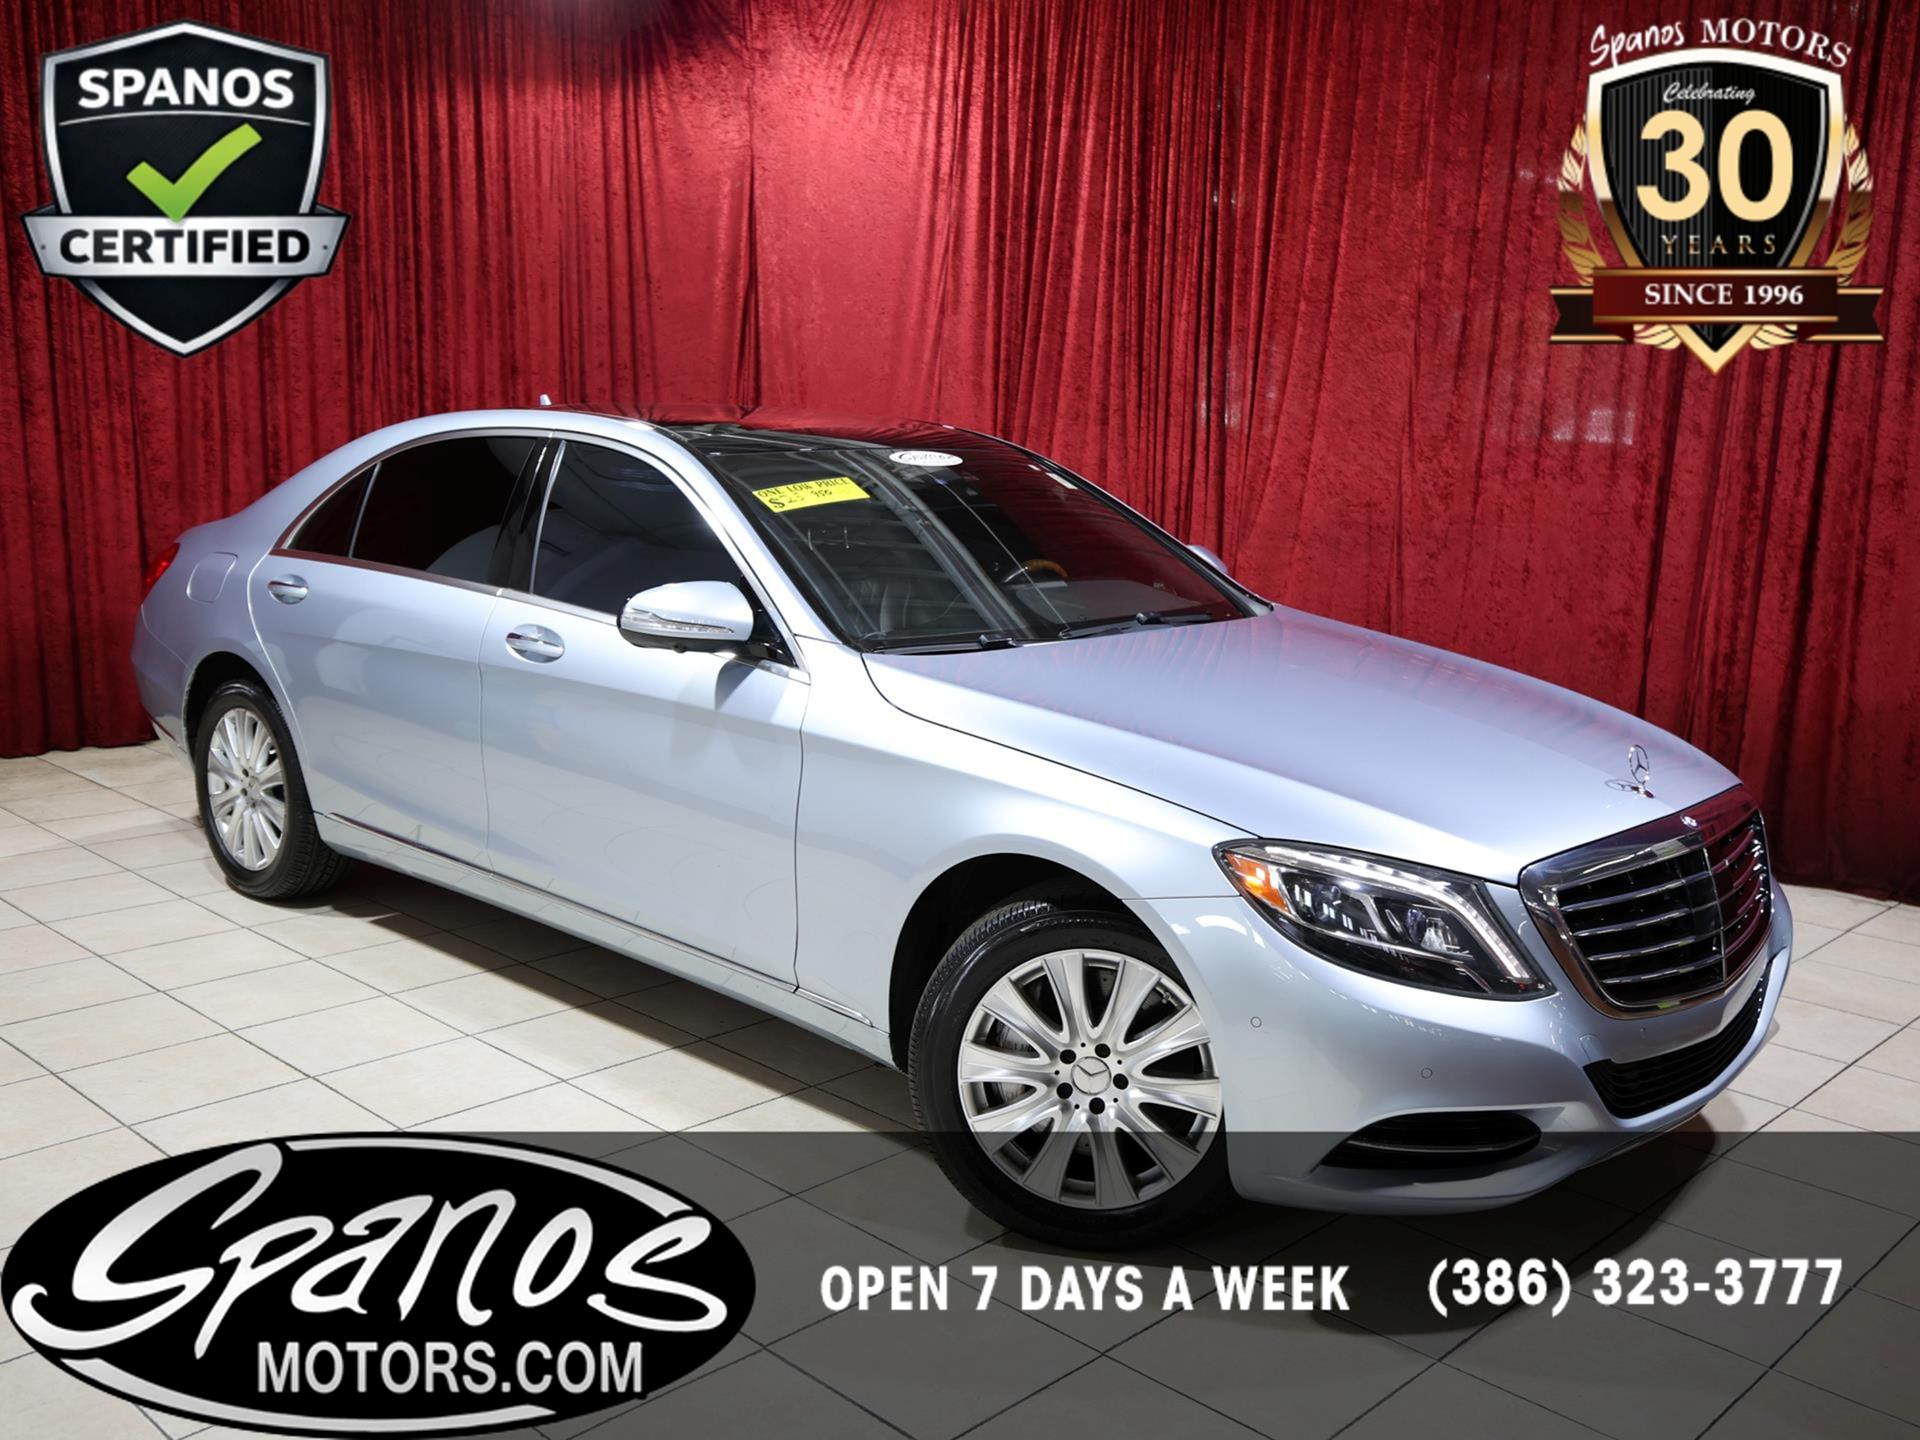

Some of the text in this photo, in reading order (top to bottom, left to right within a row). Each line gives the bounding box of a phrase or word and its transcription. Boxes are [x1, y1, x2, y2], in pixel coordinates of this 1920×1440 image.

[757, 477, 850, 499] ONE LOW PRICE
